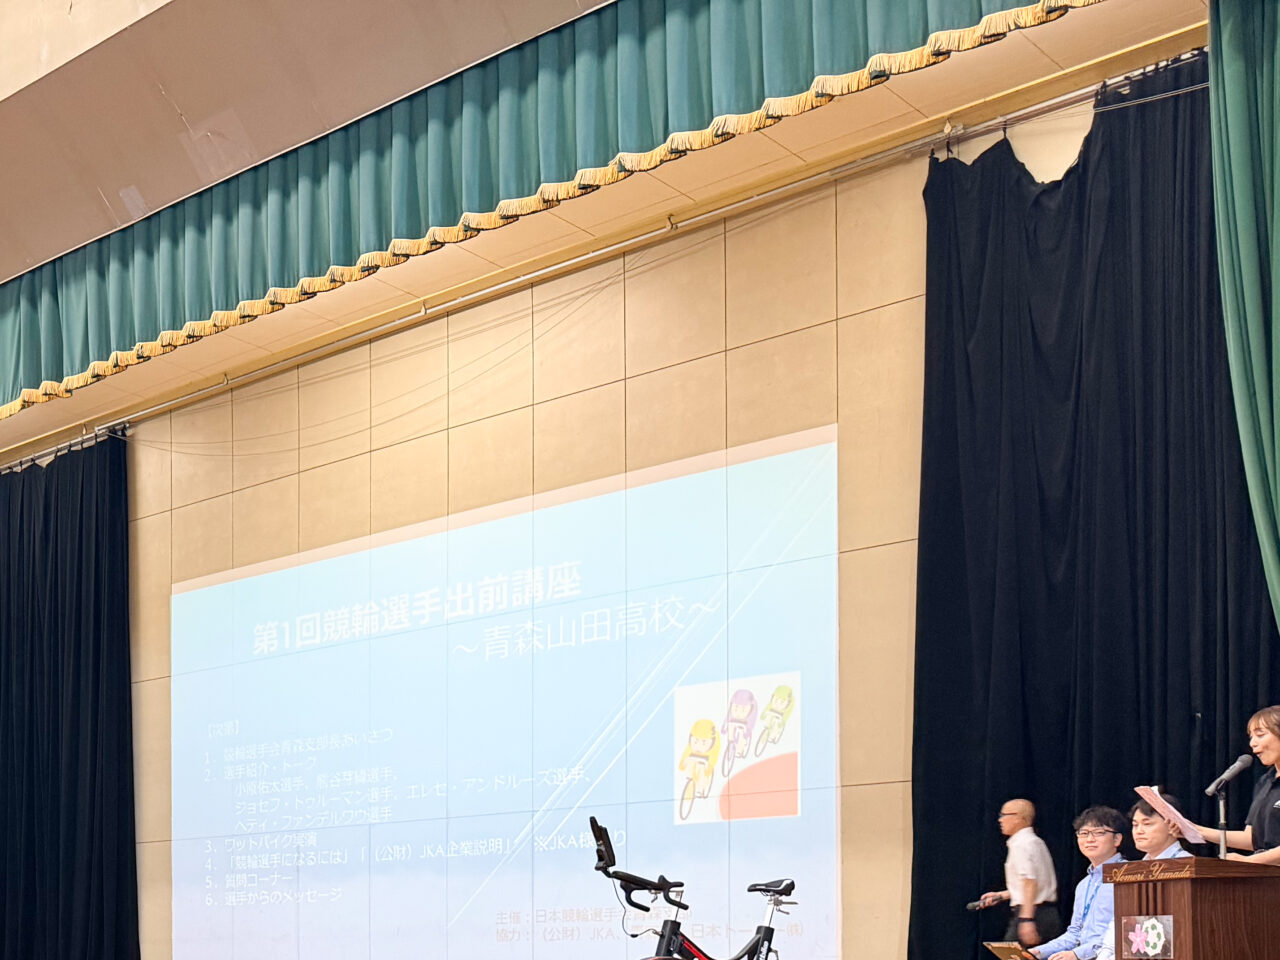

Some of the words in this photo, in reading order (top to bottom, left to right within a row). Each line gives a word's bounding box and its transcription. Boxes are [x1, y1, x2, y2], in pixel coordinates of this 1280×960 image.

[252, 560, 583, 656] 第1回競輪選手出前講座
[224, 872, 293, 888] 質問コーナー
